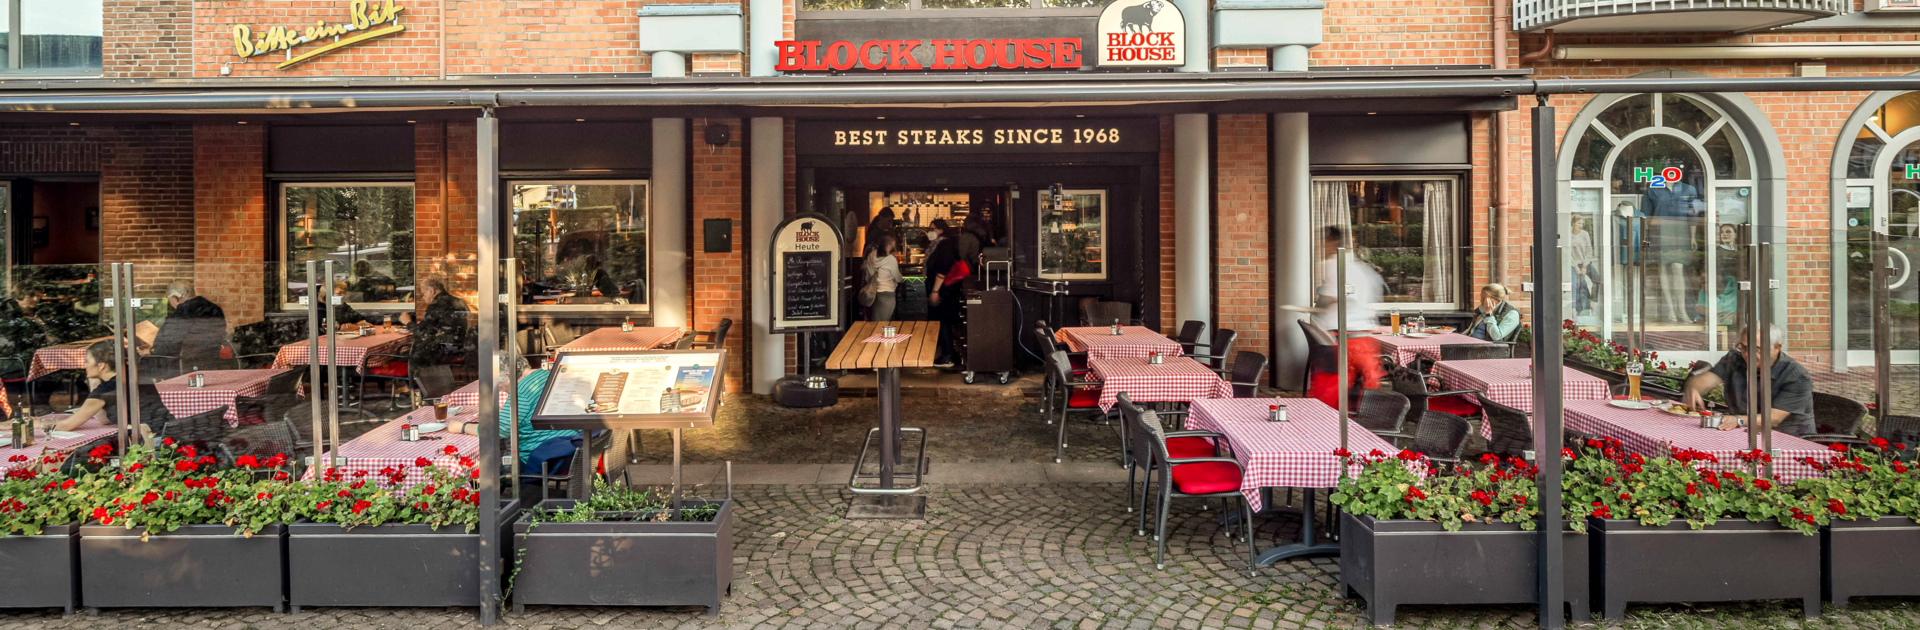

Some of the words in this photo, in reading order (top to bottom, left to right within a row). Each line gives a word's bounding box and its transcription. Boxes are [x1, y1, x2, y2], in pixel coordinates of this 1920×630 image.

[233, 24, 299, 57] Bitte
[305, 20, 347, 39] ein
[350, 0, 404, 30] Bit
[1106, 32, 1175, 46] BLOCK
[774, 39, 923, 71] BLOCK
[931, 37, 1082, 70] HOUSE
[1106, 46, 1176, 61] HOUSE
[834, 130, 888, 146] BEST
[897, 129, 984, 145] STEAKS
[994, 129, 1063, 145] SINCE
[1073, 128, 1121, 144] 1968
